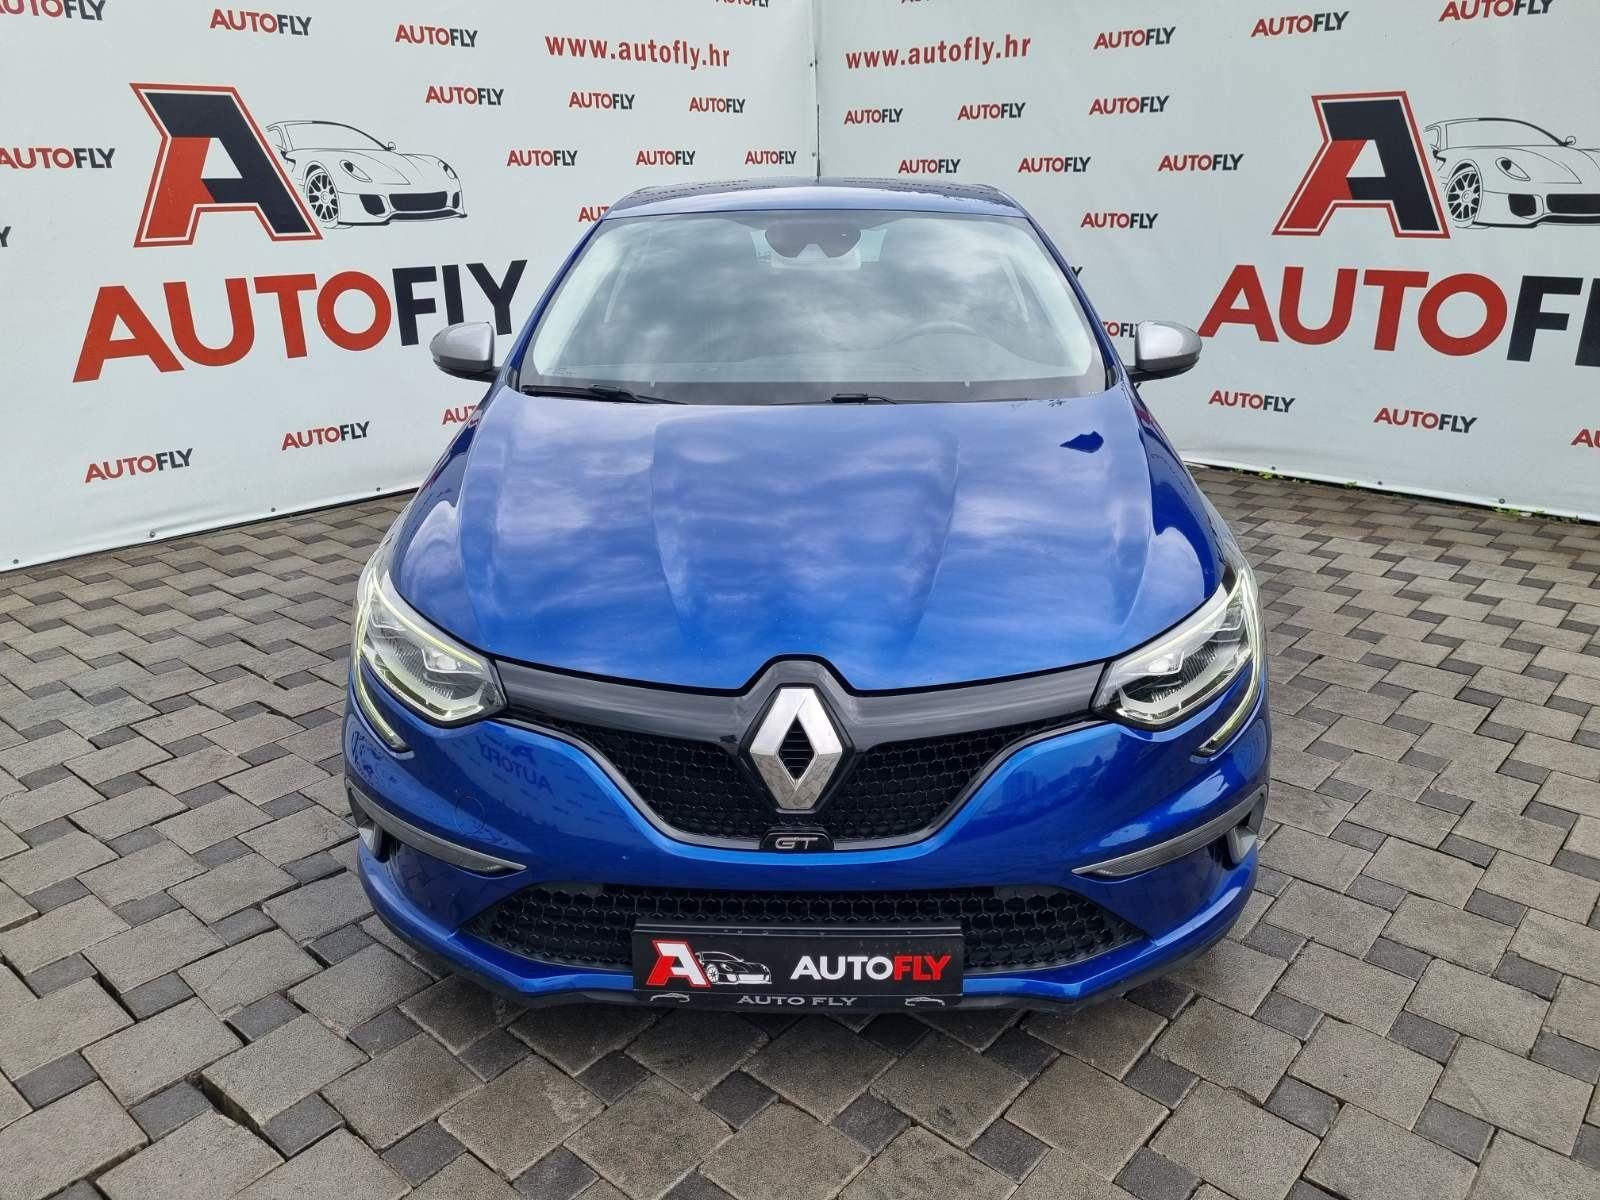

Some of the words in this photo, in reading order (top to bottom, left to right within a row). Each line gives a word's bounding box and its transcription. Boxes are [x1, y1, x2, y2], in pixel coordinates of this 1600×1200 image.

[210, 9, 312, 36] AUTOFLY
[1251, 11, 1349, 37] AUTOFLY
[395, 24, 478, 47] AUTOFLY
[1094, 26, 1176, 49] AUTOFLY
[545, 36, 729, 70] www.autofly.hr
[846, 34, 1031, 69] www.autofly.hr
[426, 86, 504, 105] AUTOFLY
[569, 92, 635, 110] AUTOFLY
[689, 97, 745, 113] AUTOFLY
[1089, 95, 1169, 115] AUTOFLY
[844, 108, 903, 124] AUTOFLY
[958, 102, 1026, 120] AUTOFLY
[0, 148, 115, 169] AUTOFLY
[507, 150, 578, 166] AUTOFLY
[636, 151, 695, 165] AUTOFLY
[745, 151, 797, 164] AUTOFLY
[898, 159, 960, 173] AUTOFLY
[1018, 157, 1091, 173] AUTOFLY
[1158, 154, 1244, 171] AUTOFLY
[1081, 213, 1158, 229] AUTOFLY
[1209, 391, 1295, 413] AUTOFLY
[1374, 408, 1477, 433] AUTOFLY
[282, 421, 369, 451] AUTOFLY
[85, 448, 193, 483] AUTOFLY
[775, 836, 819, 850] GT
[790, 955, 952, 981] AUTOFLY
[737, 995, 805, 1006] AUTO
[812, 997, 857, 1006] FLY
